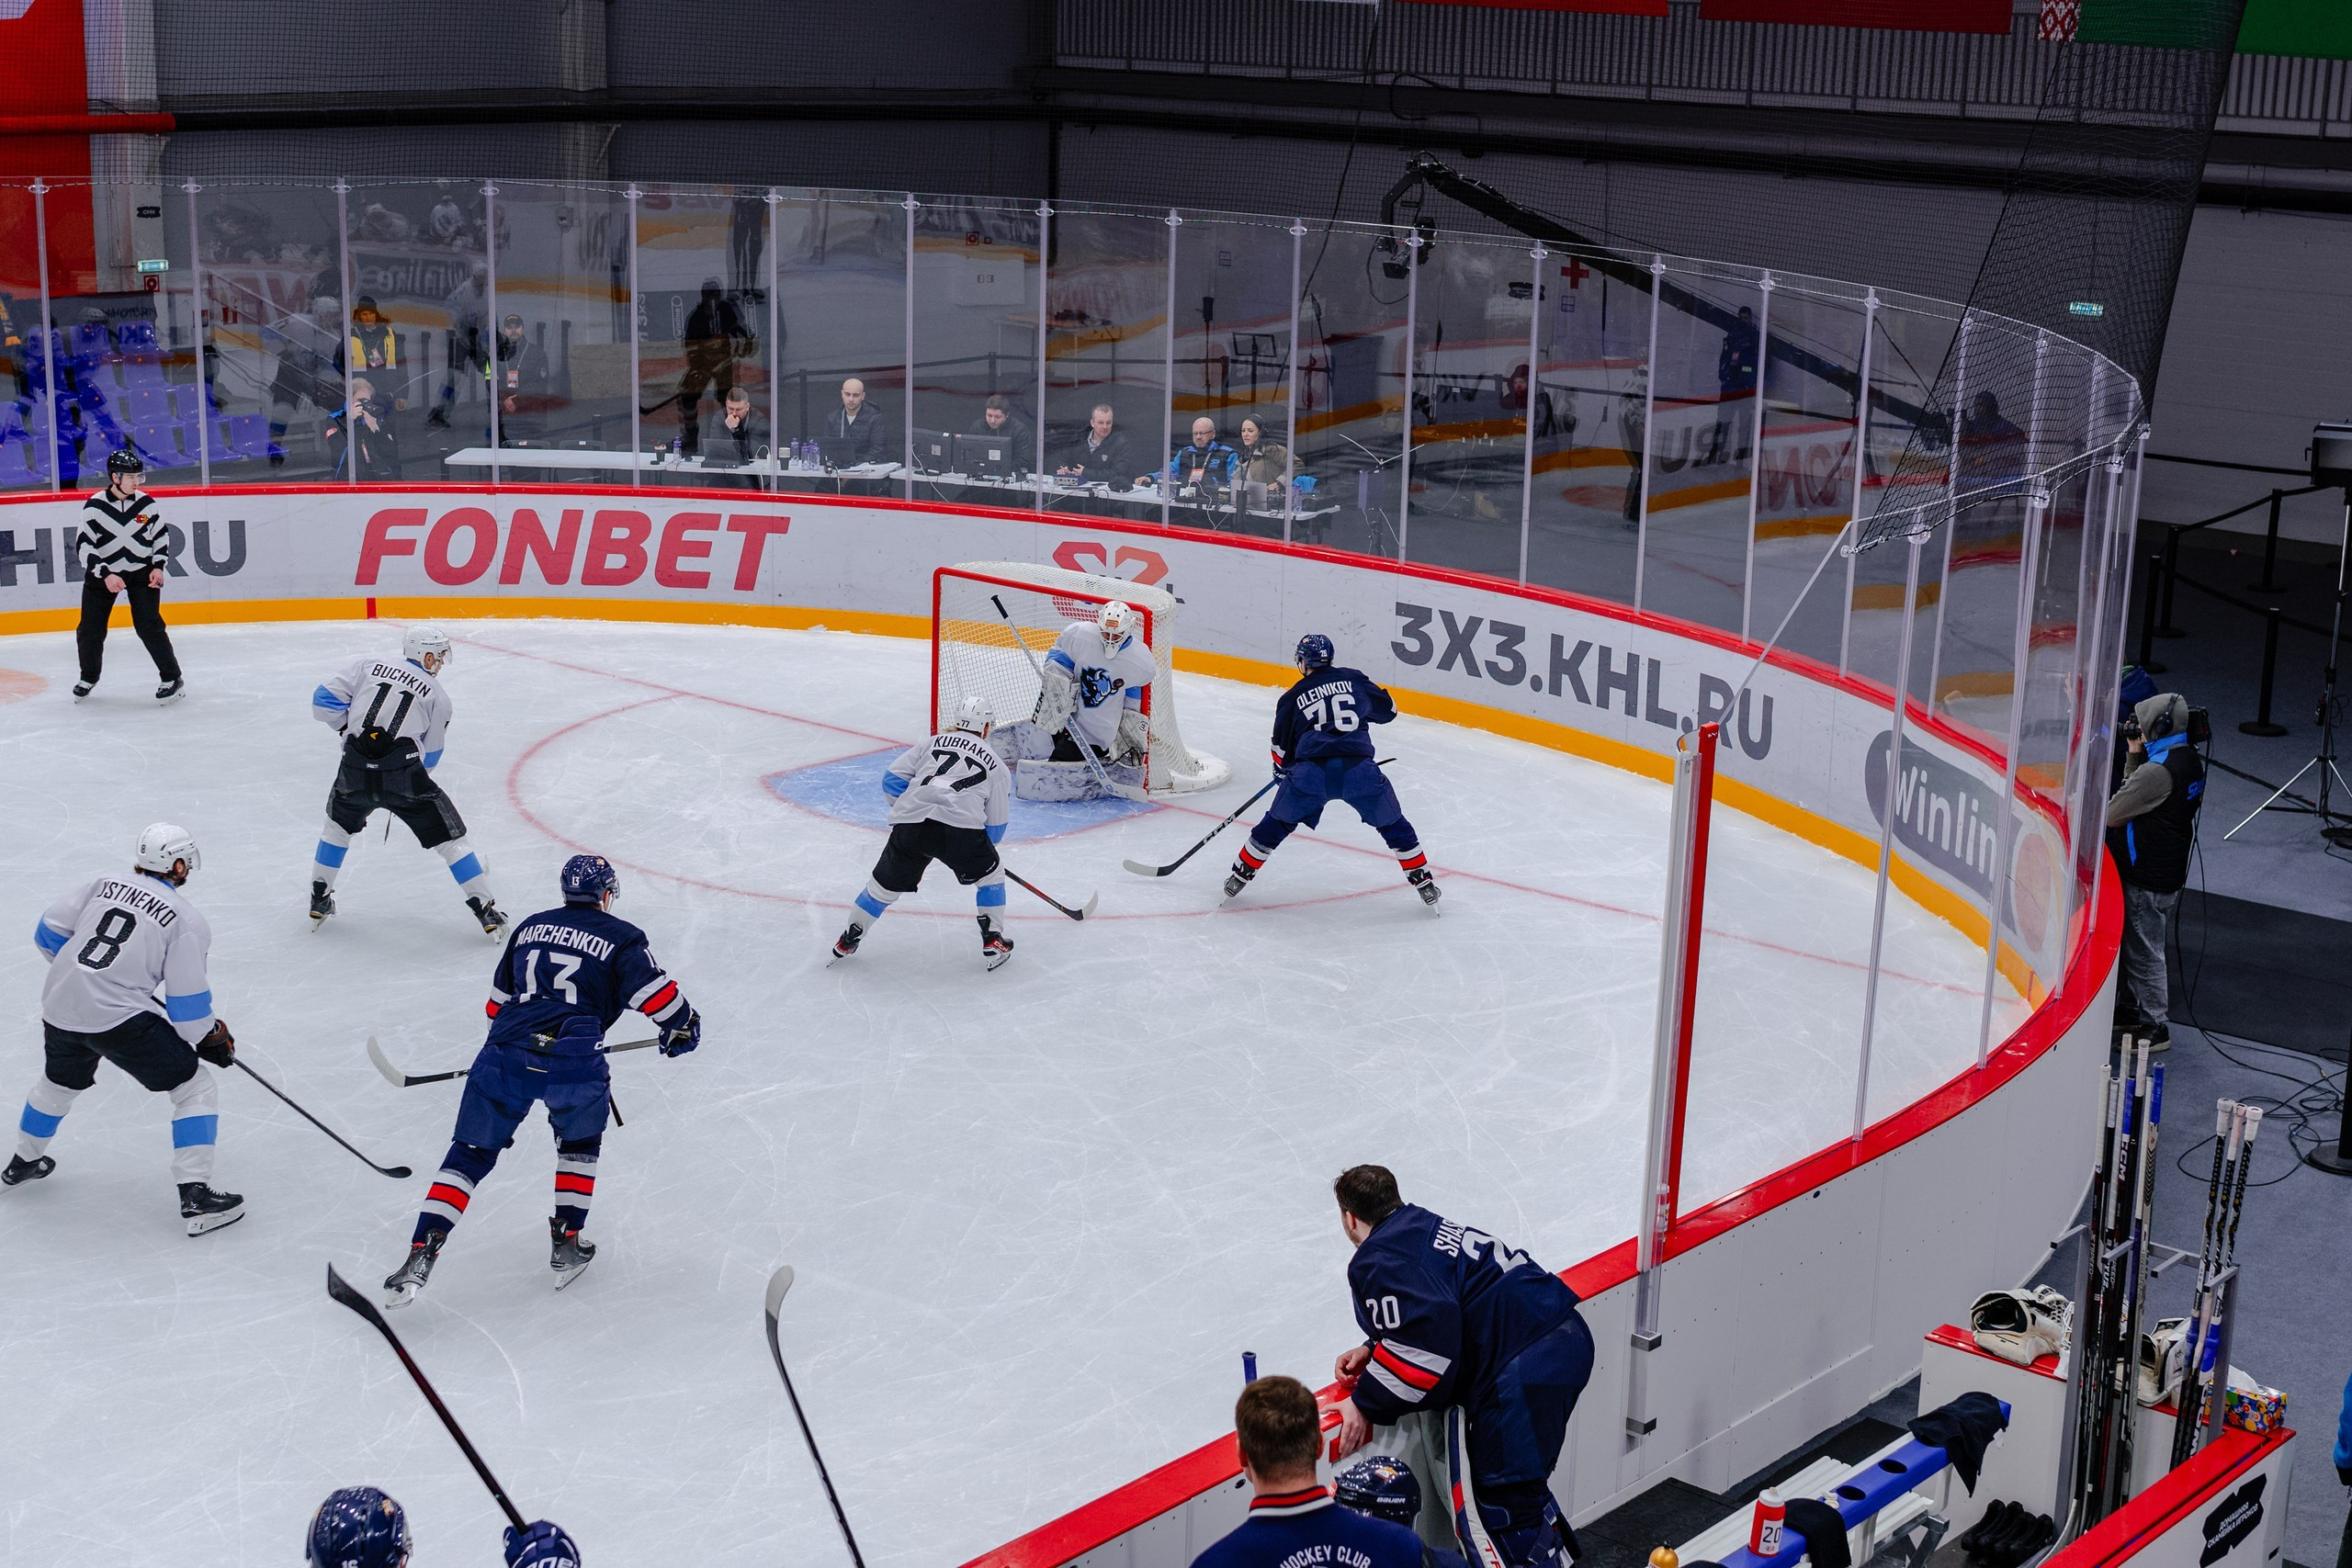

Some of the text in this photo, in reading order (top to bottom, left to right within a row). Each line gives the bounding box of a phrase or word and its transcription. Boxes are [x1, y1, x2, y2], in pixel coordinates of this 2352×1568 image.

[355, 507, 791, 592] FONBET
[371, 663, 432, 698] BUCHKIN
[1296, 681, 1353, 710] OLEINIKOV
[1390, 602, 1774, 761] 3X3.KHL.RU
[362, 682, 415, 741] 11
[961, 719, 970, 728] 77
[1031, 691, 1046, 725] CCM
[1303, 694, 1360, 732] 76
[920, 749, 988, 793] 77
[933, 736, 998, 772] KUBRAKOV
[1885, 750, 2003, 885] Winlin
[141, 844, 146, 854] 8
[571, 876, 581, 887] 13
[77, 907, 138, 971] 8
[515, 924, 616, 962] MARCHENKOV
[519, 949, 583, 1005] 13
[1366, 1295, 1400, 1330] 20
[1376, 1496, 1407, 1505] BAUER
[1762, 1526, 1782, 1544] 20
[1280, 1544, 1372, 1568] HOCKEY CLUB
